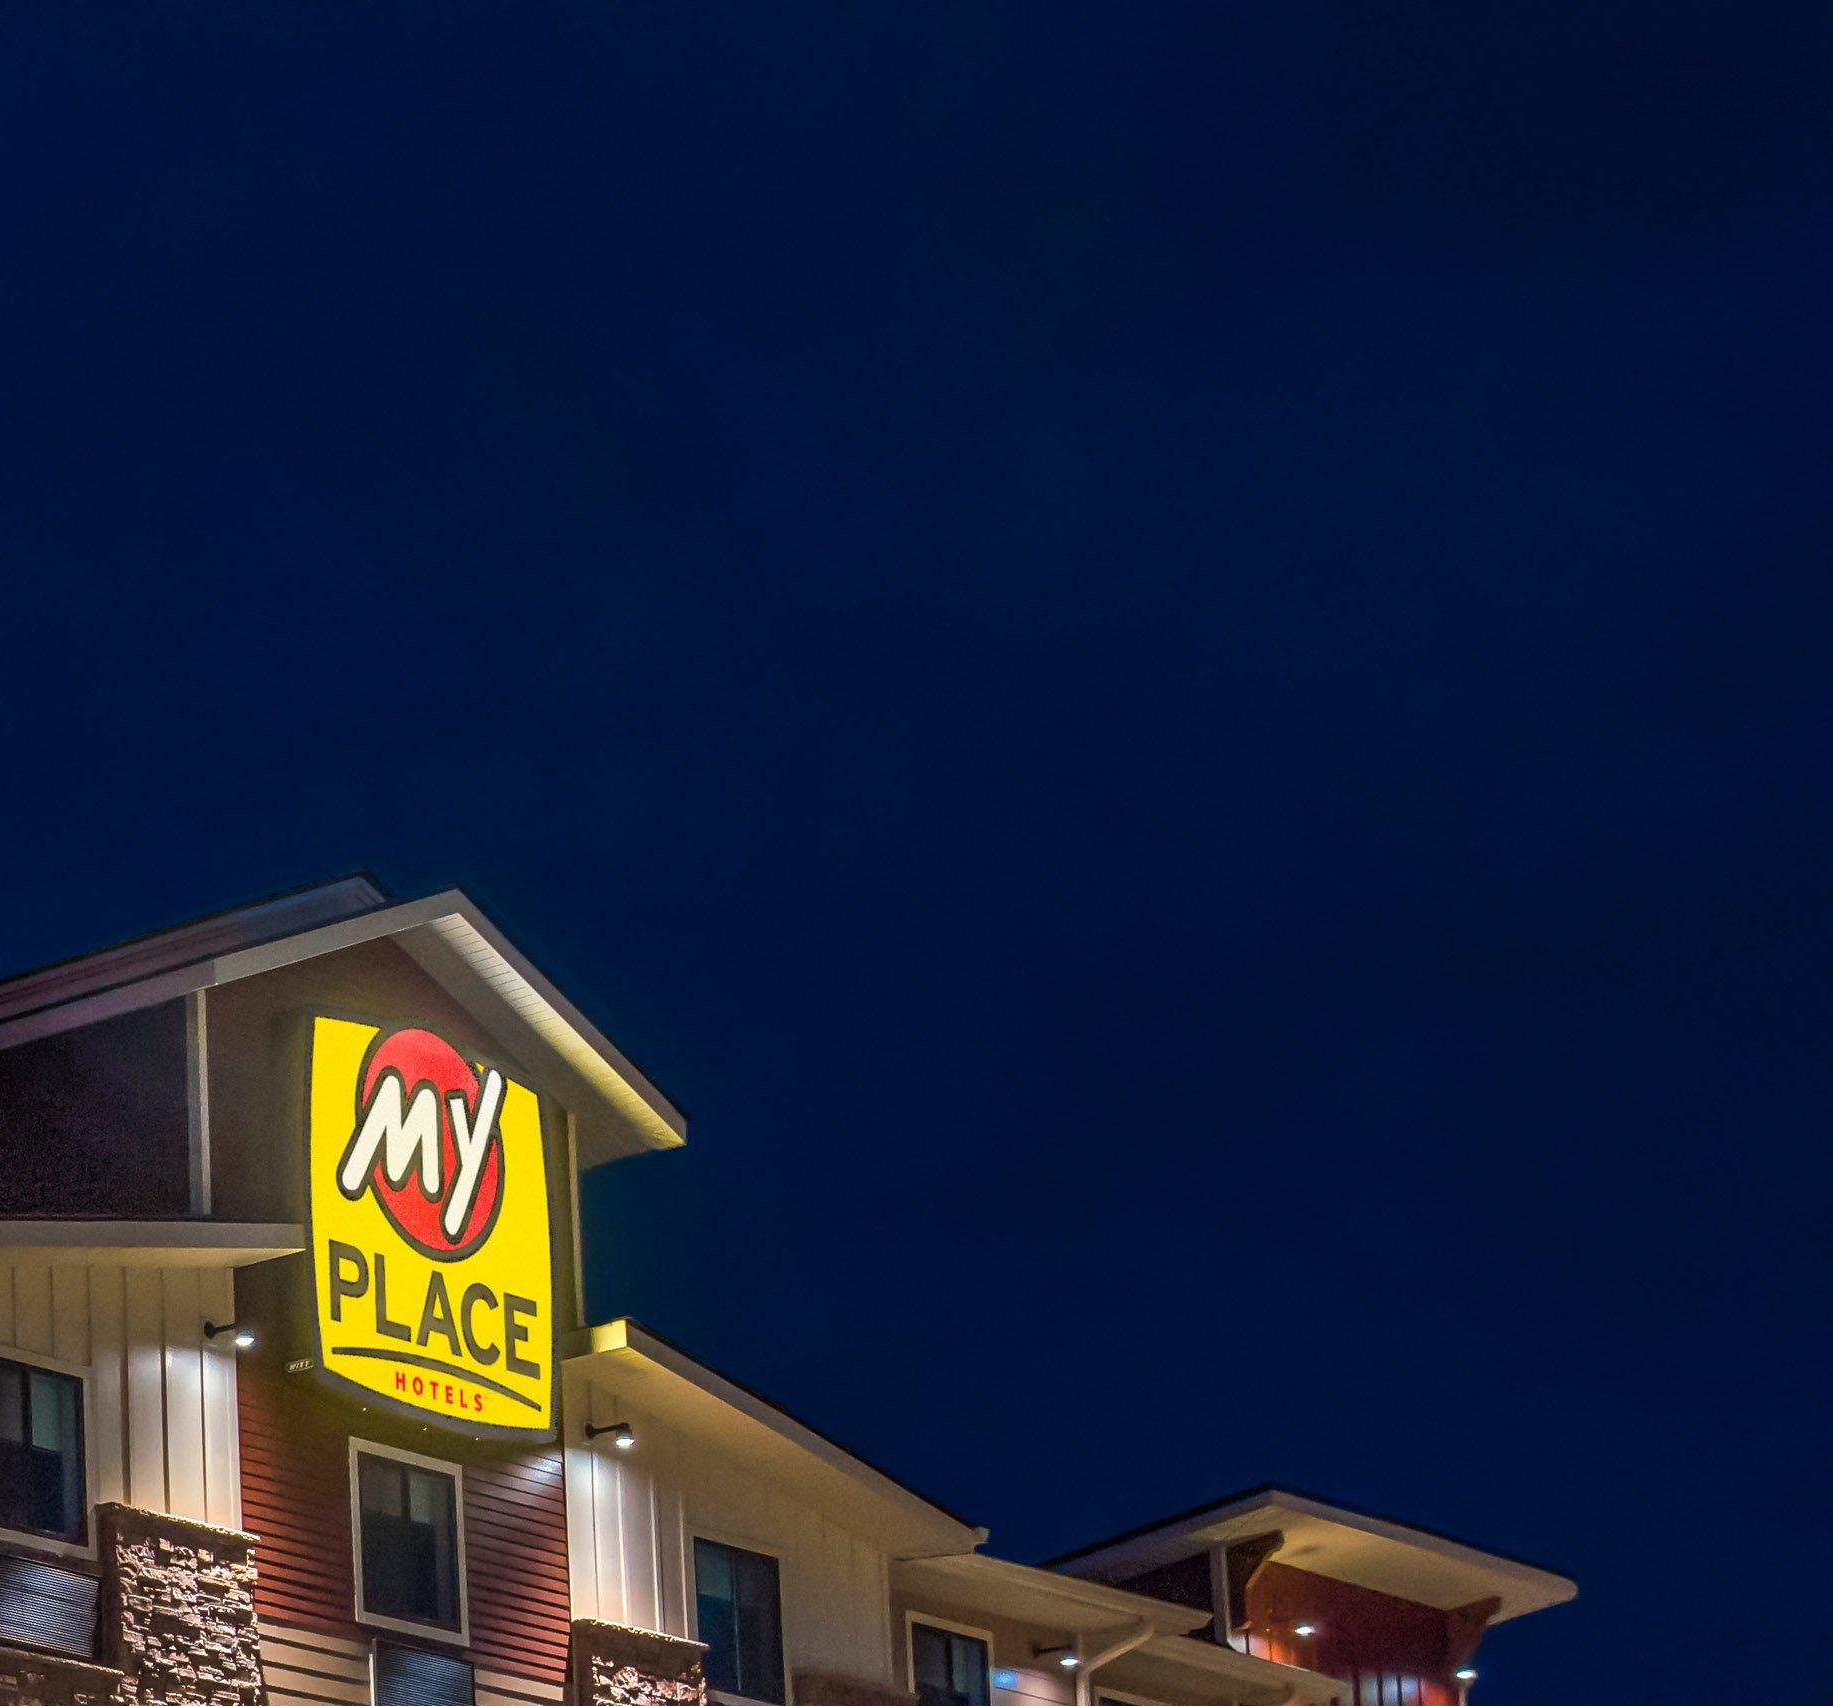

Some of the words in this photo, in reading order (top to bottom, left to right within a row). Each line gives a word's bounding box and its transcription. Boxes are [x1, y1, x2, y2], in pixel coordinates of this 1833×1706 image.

[341, 1068, 502, 1236] MY
[328, 1240, 541, 1380] PLACE
[395, 1371, 483, 1413] HOTELS
